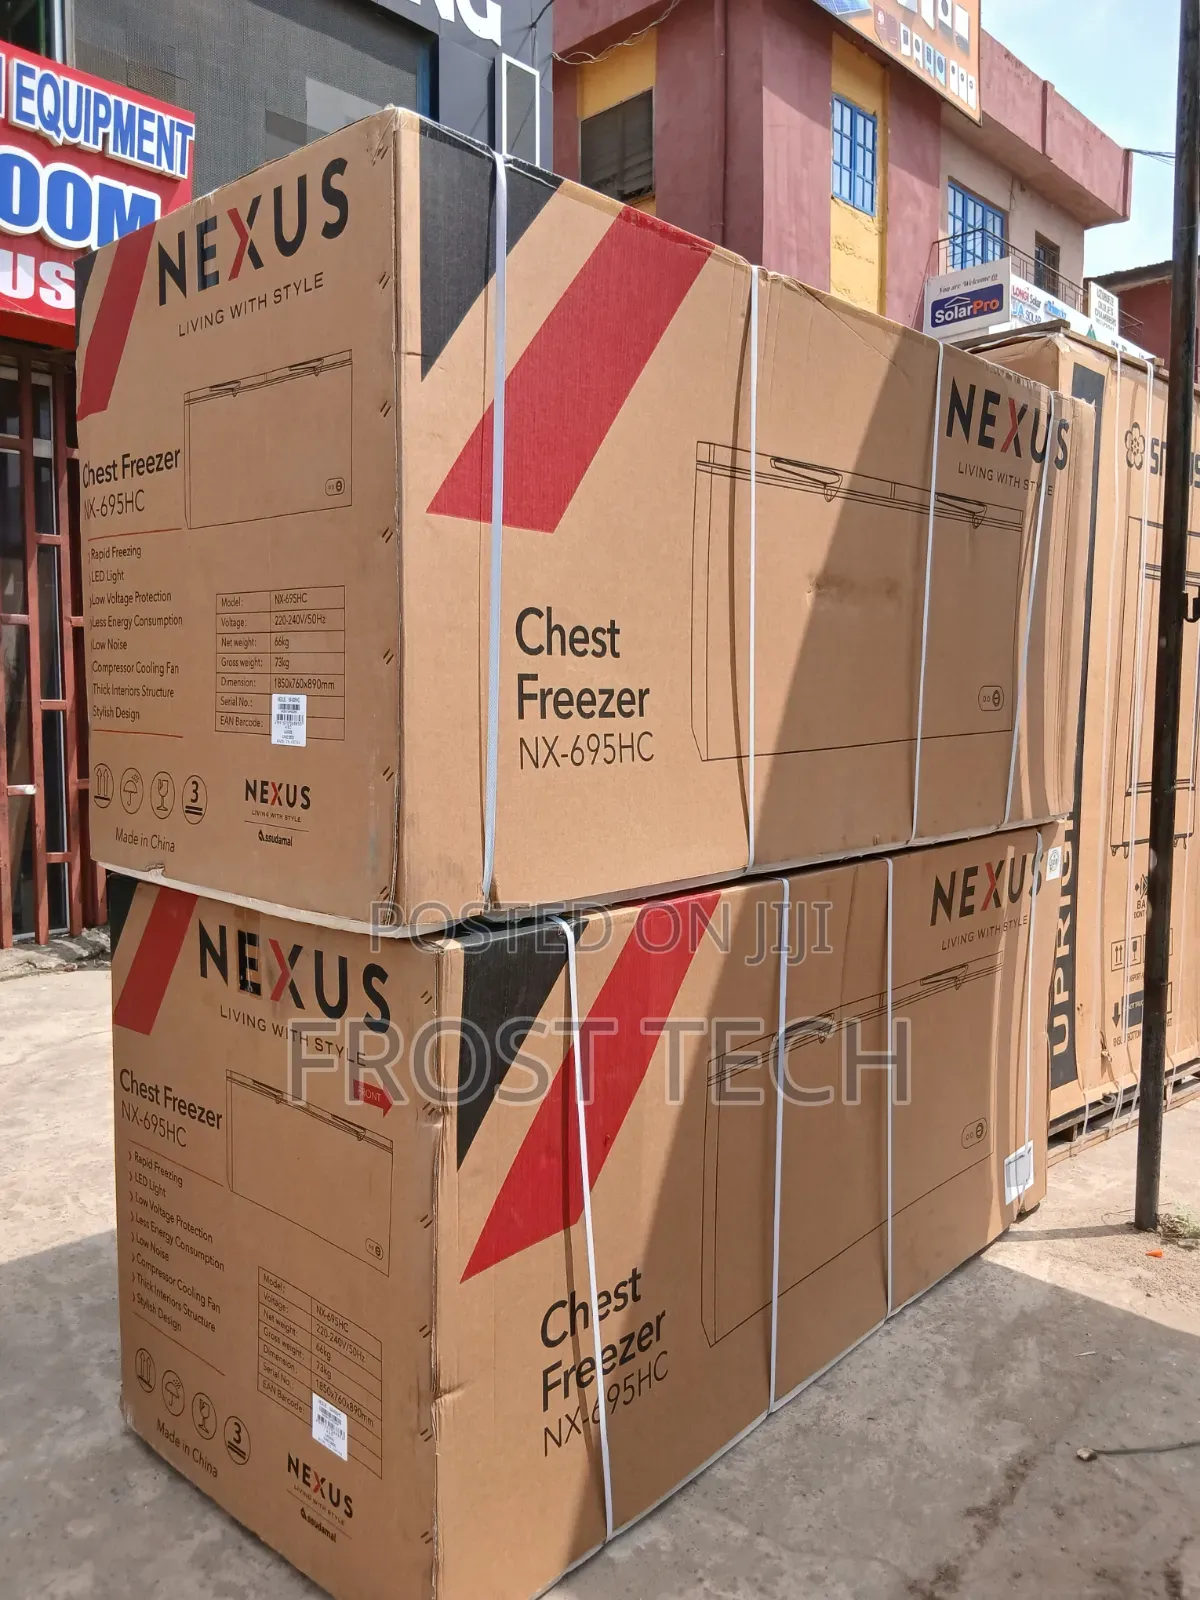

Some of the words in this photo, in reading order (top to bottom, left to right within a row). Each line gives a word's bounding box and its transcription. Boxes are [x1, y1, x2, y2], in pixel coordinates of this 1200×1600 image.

[12, 60, 193, 178] EQUIPMENT
[158, 157, 349, 307] NEXUS
[178, 309, 225, 338] LIVING
[229, 293, 268, 320] WITH
[273, 271, 324, 304] STYLE
[935, 298, 999, 324] SolarPro
[946, 376, 1070, 471] NEXUS
[82, 459, 118, 489] Chest
[122, 448, 180, 480] Freezer
[958, 461, 993, 481] LIVING
[996, 471, 1020, 489] WITH
[84, 489, 146, 522] NX-695HC
[91, 546, 111, 562] Rapid
[112, 545, 142, 559] Freezing
[91, 570, 105, 583] LED
[106, 568, 124, 584] Light
[92, 594, 105, 605] Low
[106, 592, 133, 607] Voltage
[135, 591, 172, 603] Protection
[221, 597, 244, 608] Model:
[274, 593, 308, 605] NX-695HC
[92, 618, 107, 628] Less
[107, 616, 133, 630] Energy
[134, 614, 183, 629] Consumption
[220, 616, 247, 629] Voltage:
[274, 613, 326, 626] 220-240V/50Hz
[515, 606, 621, 658] Chest
[92, 639, 106, 651] Low
[107, 639, 127, 651] Noise
[221, 637, 233, 647] Net
[233, 637, 257, 649] weight:
[274, 636, 290, 649] 66kg
[92, 661, 135, 675] Compressor
[135, 661, 164, 677] Cooling
[166, 661, 180, 675] Fan
[221, 656, 239, 667] Gross
[240, 657, 263, 669] weight:
[274, 656, 290, 669] 73kg
[93, 683, 111, 696] Thick
[111, 684, 141, 697] Interiors
[141, 685, 174, 698] Structure
[220, 676, 256, 688] Dimension:
[274, 678, 335, 690] 1850x760x890mm
[517, 673, 650, 720] Freezer
[93, 705, 114, 719] Stylish
[115, 707, 140, 722] Design
[220, 696, 238, 707] Serial
[220, 715, 234, 726] EAN
[235, 716, 264, 728] Barcode:
[519, 731, 654, 770] NX-695HC
[190, 780, 199, 803] 3
[245, 779, 311, 810] NEXUS
[251, 809, 269, 818] LIVING
[284, 815, 302, 823] STYLE
[115, 827, 139, 845] Made
[140, 833, 148, 847] in
[150, 834, 175, 852] China
[930, 852, 1044, 927] NEXUS
[942, 931, 974, 951] LIVING
[977, 925, 1000, 940] WITH
[1003, 915, 1028, 932] STYLE
[199, 918, 391, 1034] NEXUS
[220, 1005, 267, 1032] LIVING
[272, 1023, 309, 1047] WITH
[314, 1037, 367, 1067] STYLE
[119, 1068, 160, 1105] Chest
[164, 1085, 223, 1130] Freezer
[121, 1099, 187, 1148] NX-695HC
[134, 1151, 153, 1169] Rapid
[154, 1162, 183, 1188] Freezing
[134, 1172, 148, 1187] LED
[149, 1179, 167, 1198] Light
[135, 1191, 148, 1208] Low
[149, 1198, 175, 1224] Voltage
[176, 1214, 213, 1244] Protection
[135, 1211, 150, 1229] Less
[151, 1221, 174, 1246] Energy
[175, 1235, 225, 1272] Consumption
[136, 1232, 149, 1249] Low
[150, 1244, 169, 1262] Noise
[137, 1252, 176, 1286] Compressor
[177, 1278, 206, 1308] Cooling
[207, 1296, 221, 1314] Fan
[263, 1273, 286, 1294] Model:
[136, 1292, 157, 1315] Stylish
[157, 1307, 182, 1332] Design
[137, 1272, 154, 1293] Thick
[154, 1285, 182, 1312] Interiors
[183, 1303, 216, 1333] Structure
[263, 1291, 289, 1314] Voltage:
[263, 1308, 275, 1323] Net
[540, 1267, 642, 1349] Chest
[316, 1305, 349, 1333] NX-695HC
[263, 1326, 281, 1345] Gross
[316, 1323, 366, 1363] 220-240V/50Hz
[316, 1342, 331, 1362] 66kg
[542, 1310, 666, 1413] Freezer
[263, 1362, 280, 1381] Serial
[316, 1360, 332, 1380] 73kg
[262, 1380, 277, 1395] EAN
[277, 1386, 305, 1414] Barcode:
[315, 1379, 374, 1428] 1850x760x890mm
[544, 1350, 669, 1457] NX-695HC
[156, 1418, 180, 1448] Made
[182, 1440, 190, 1457] in
[192, 1448, 218, 1478] China
[287, 1452, 353, 1519] NEXUS
